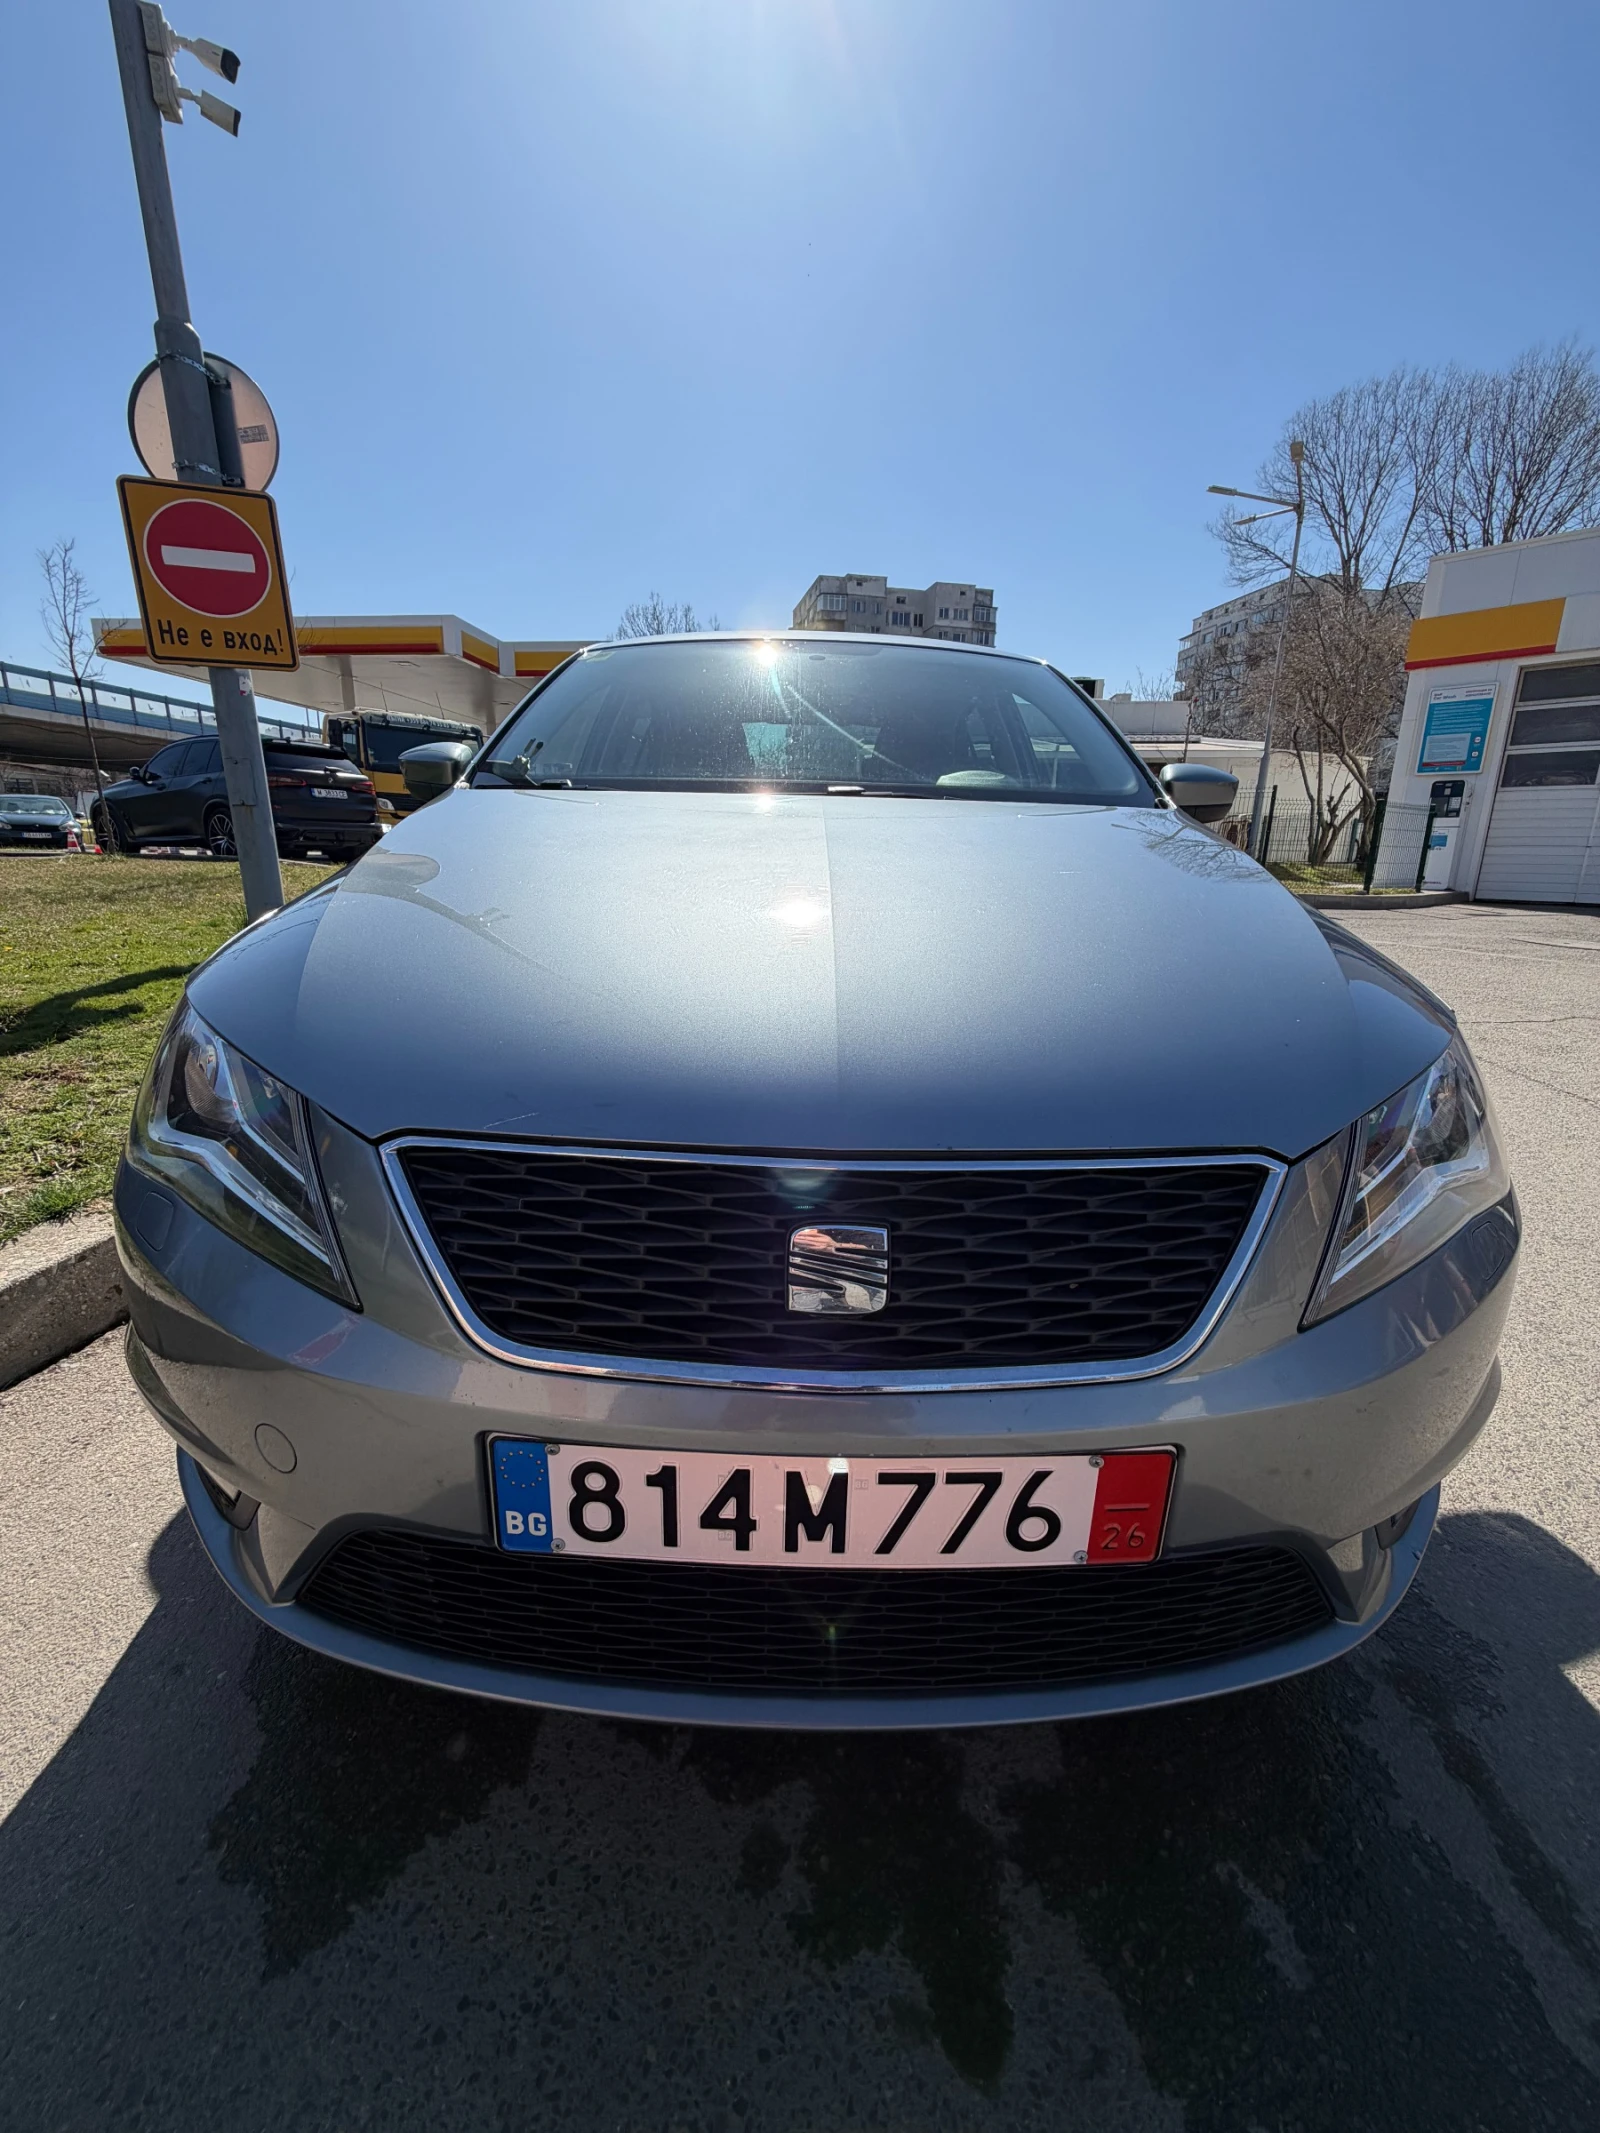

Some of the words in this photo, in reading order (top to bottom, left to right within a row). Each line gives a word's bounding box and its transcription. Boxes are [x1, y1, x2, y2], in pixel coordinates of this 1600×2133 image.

[157, 619, 189, 646] Не
[200, 629, 213, 648] е
[222, 628, 284, 656] вход!
[505, 1510, 547, 1536] BG
[1101, 1522, 1145, 1549] 26
